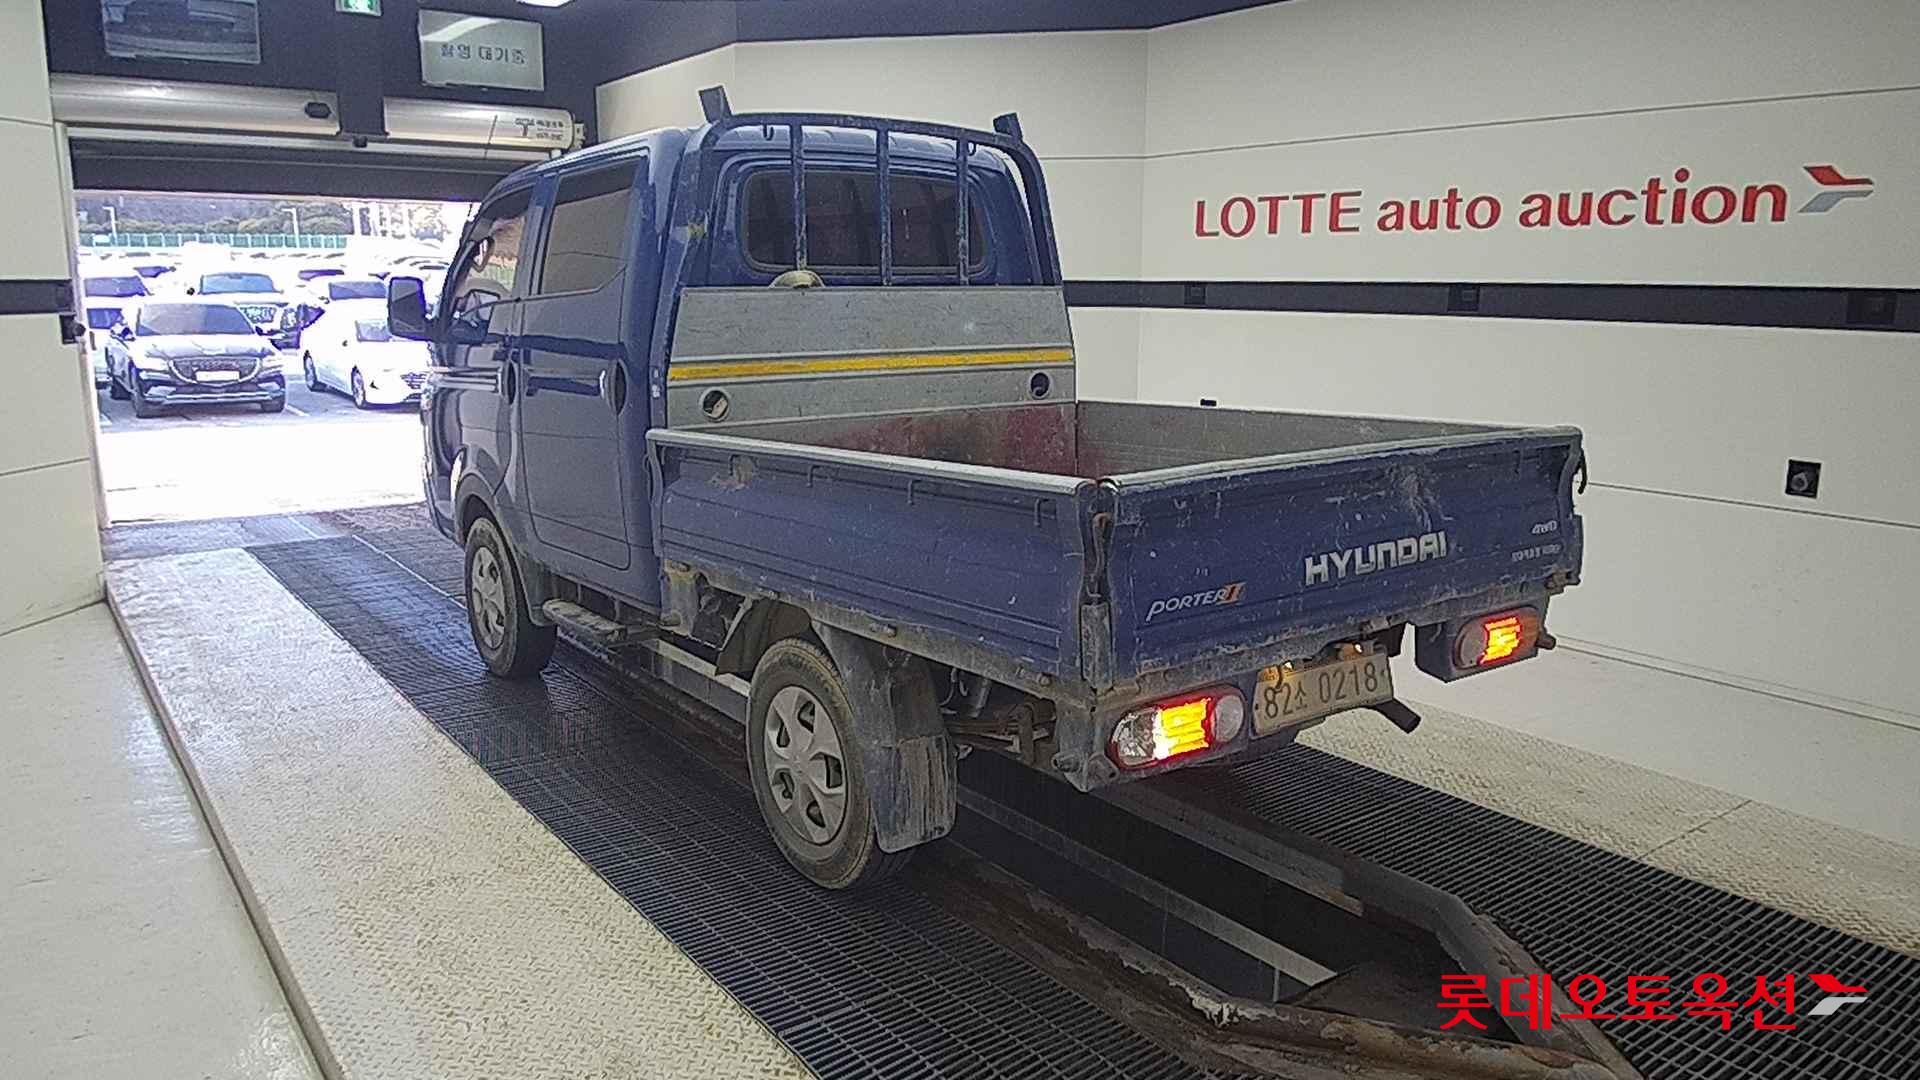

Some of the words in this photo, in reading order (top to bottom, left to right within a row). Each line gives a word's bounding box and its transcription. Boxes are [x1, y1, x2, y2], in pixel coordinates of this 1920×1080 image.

[1195, 190, 1362, 238] LOTTE
[1376, 187, 1502, 232] auto
[1518, 167, 1788, 228] auction
[1304, 531, 1447, 586] HYUNDAI
[1318, 662, 1378, 703] 0218
